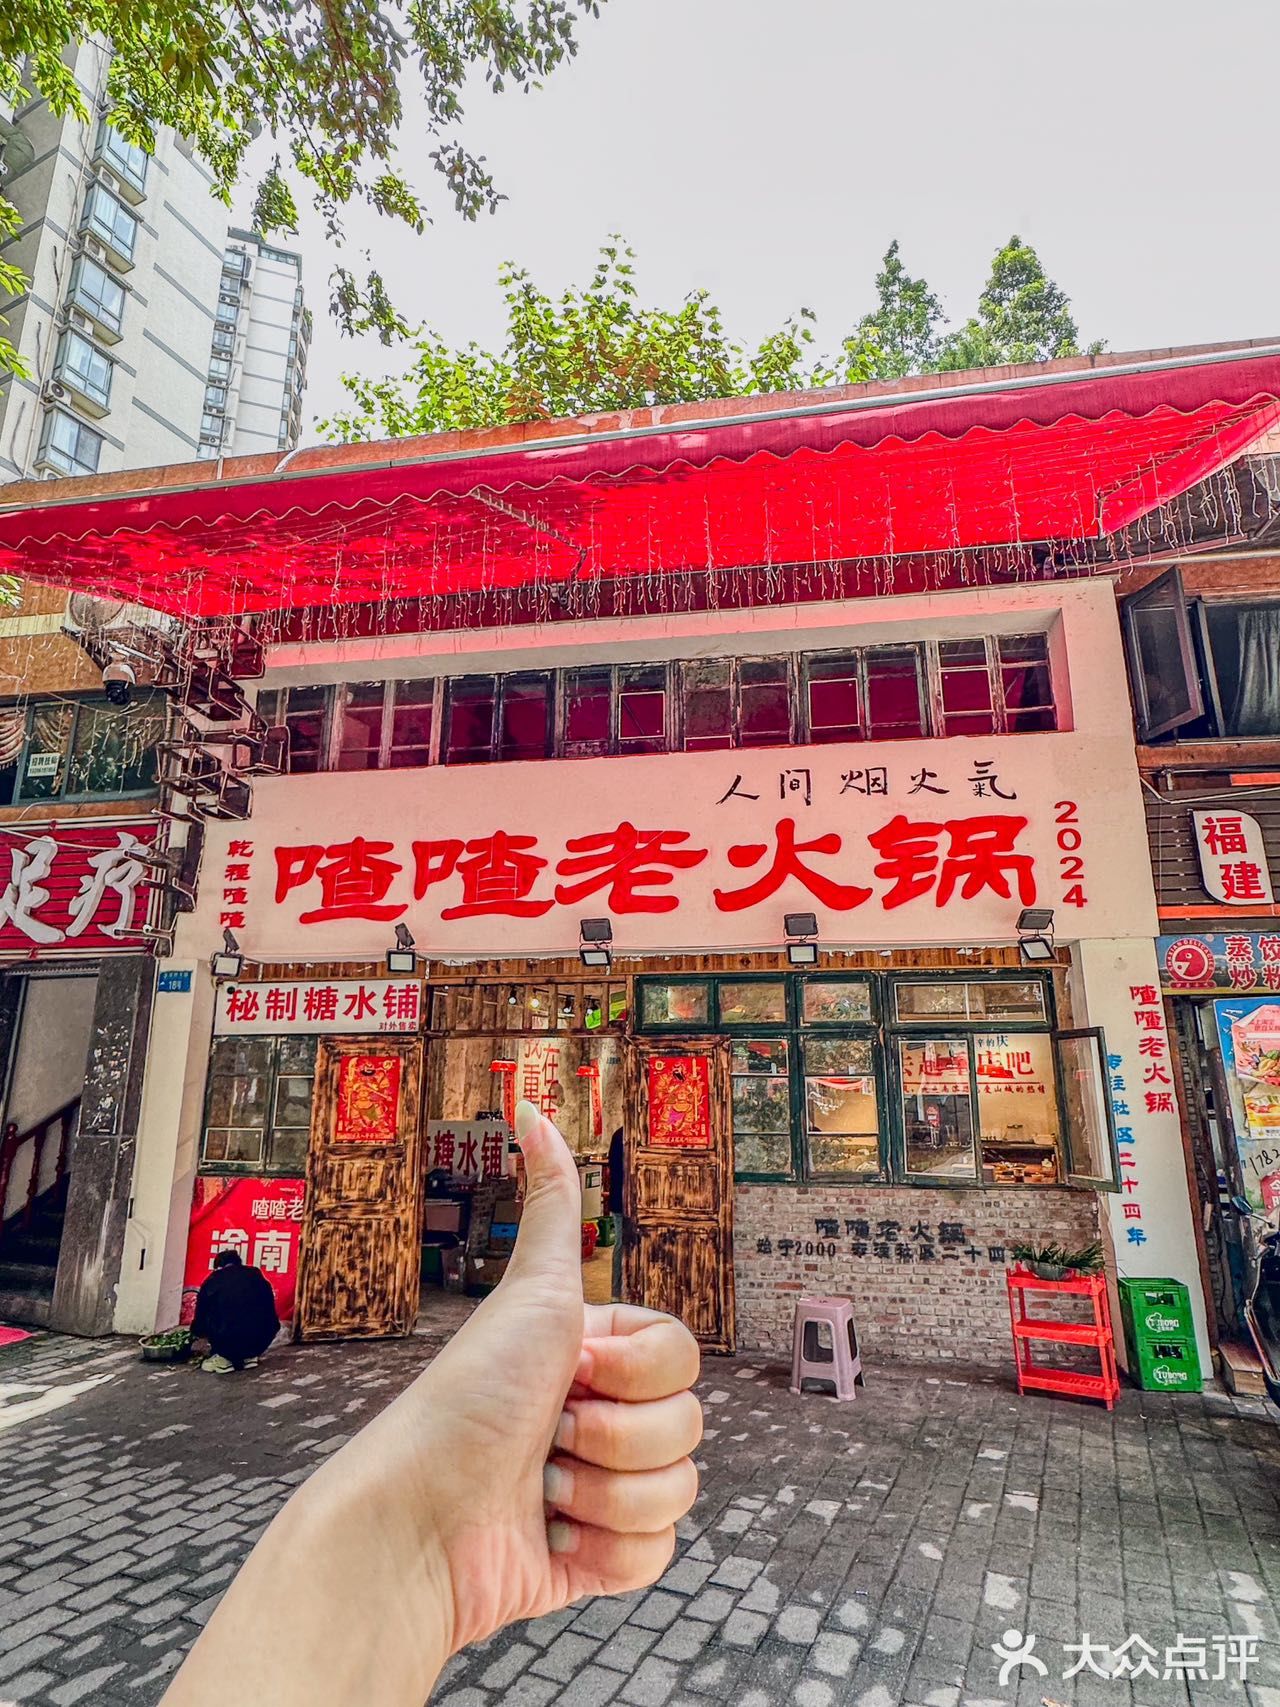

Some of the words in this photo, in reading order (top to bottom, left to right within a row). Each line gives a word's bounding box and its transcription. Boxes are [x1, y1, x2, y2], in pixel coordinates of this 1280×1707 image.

[274, 815, 1037, 924] 喳喳老火锅
[1054, 801, 1088, 908] 2024
[1202, 816, 1266, 900] 福建
[226, 984, 419, 1022] 秘制糖水铺
[1129, 985, 1174, 1114] 喳喳老火锅
[427, 1130, 504, 1178] 糖水铺
[252, 1196, 304, 1221] 喳喳老
